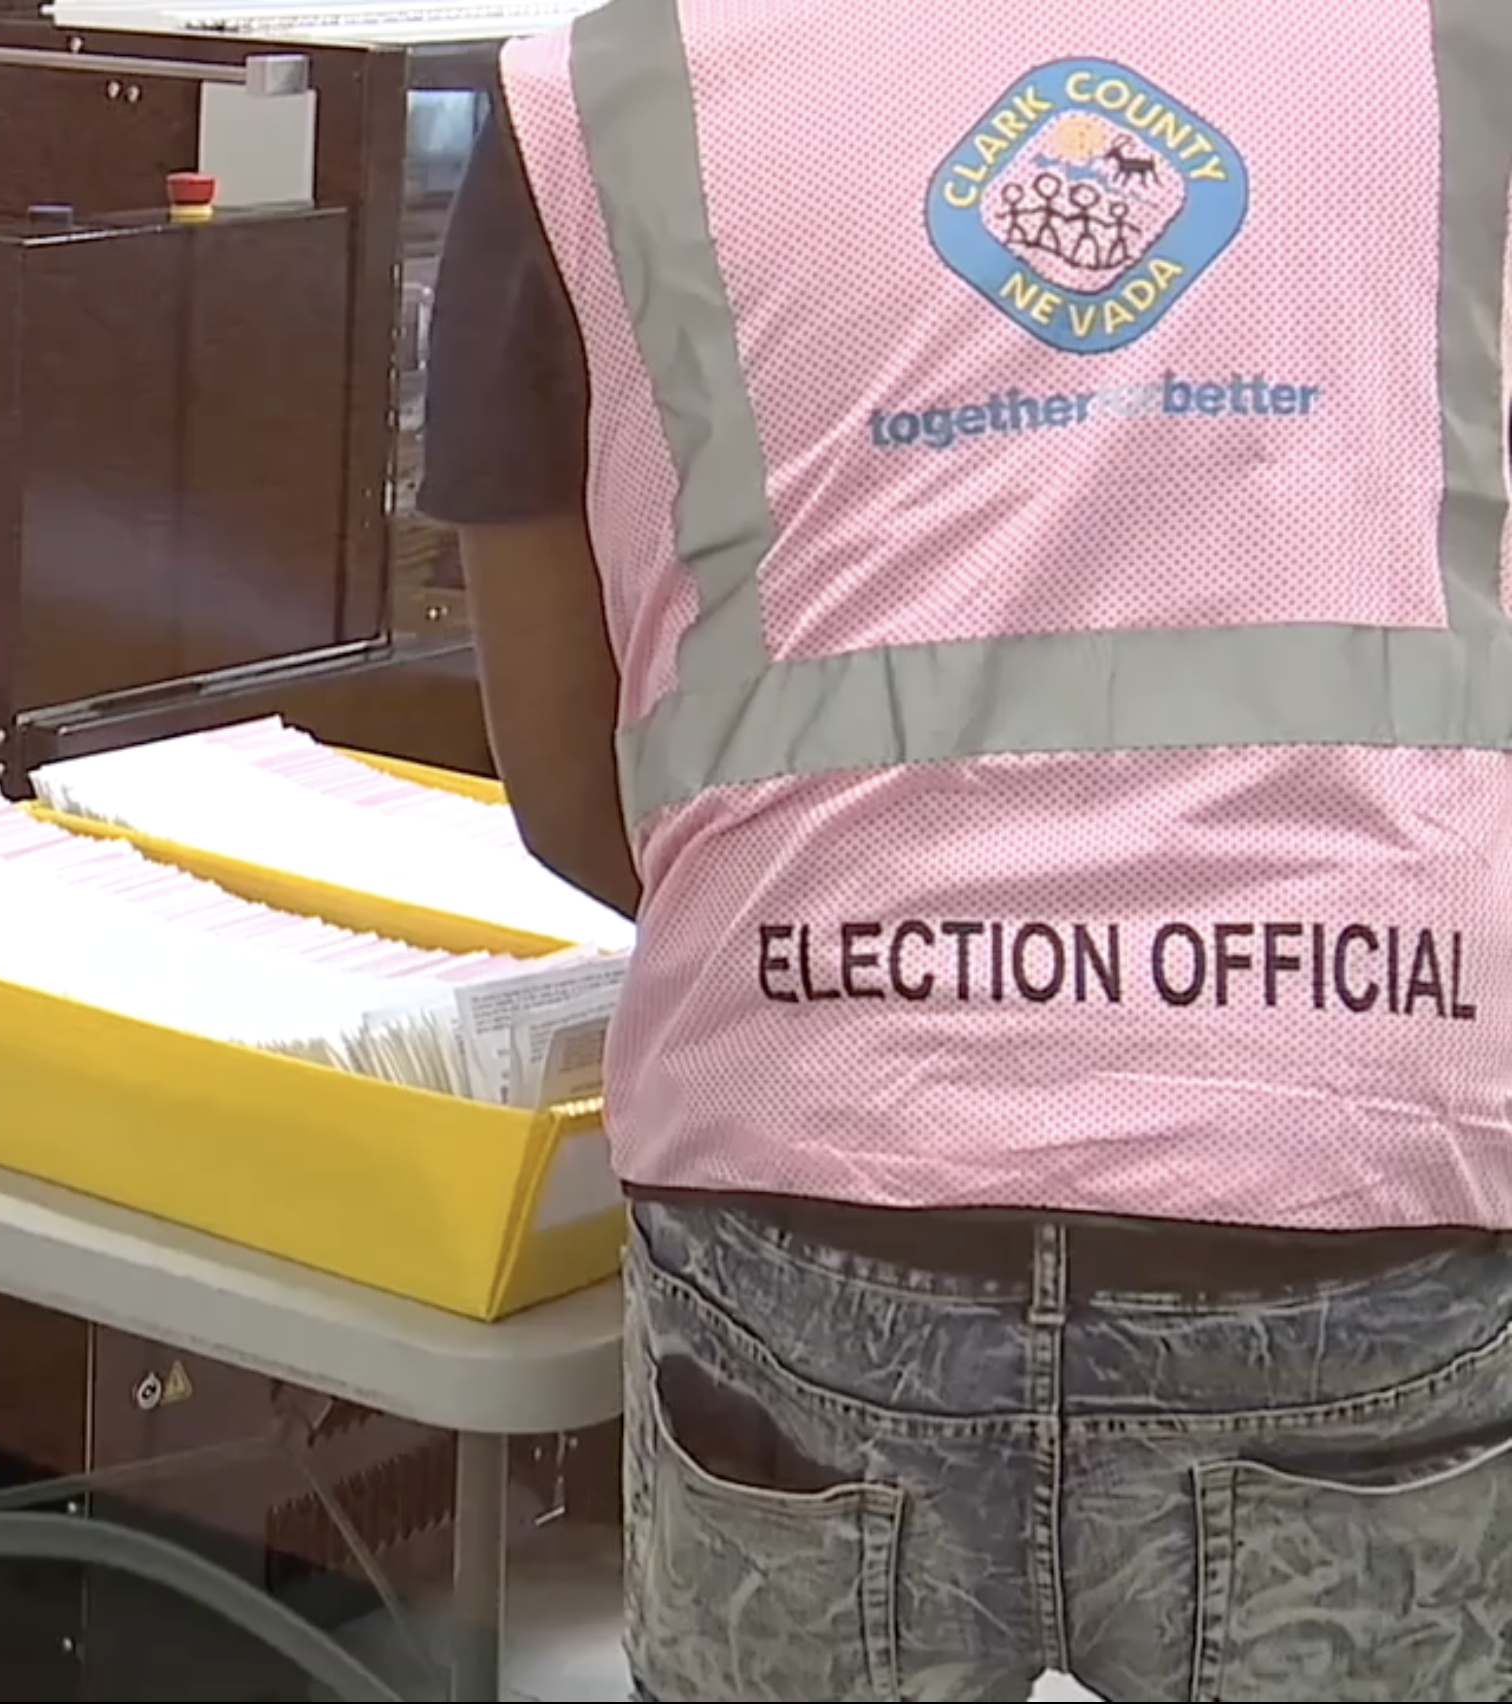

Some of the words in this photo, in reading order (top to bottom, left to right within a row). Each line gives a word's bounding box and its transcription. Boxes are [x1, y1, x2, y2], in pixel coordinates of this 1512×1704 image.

[943, 85, 1053, 209] CLARK
[1065, 71, 1227, 186] COUNTY
[867, 388, 1099, 449] together
[1160, 370, 1322, 416] better
[758, 919, 1122, 1003] ELECTION
[1151, 922, 1478, 1021] OFFICIAL
